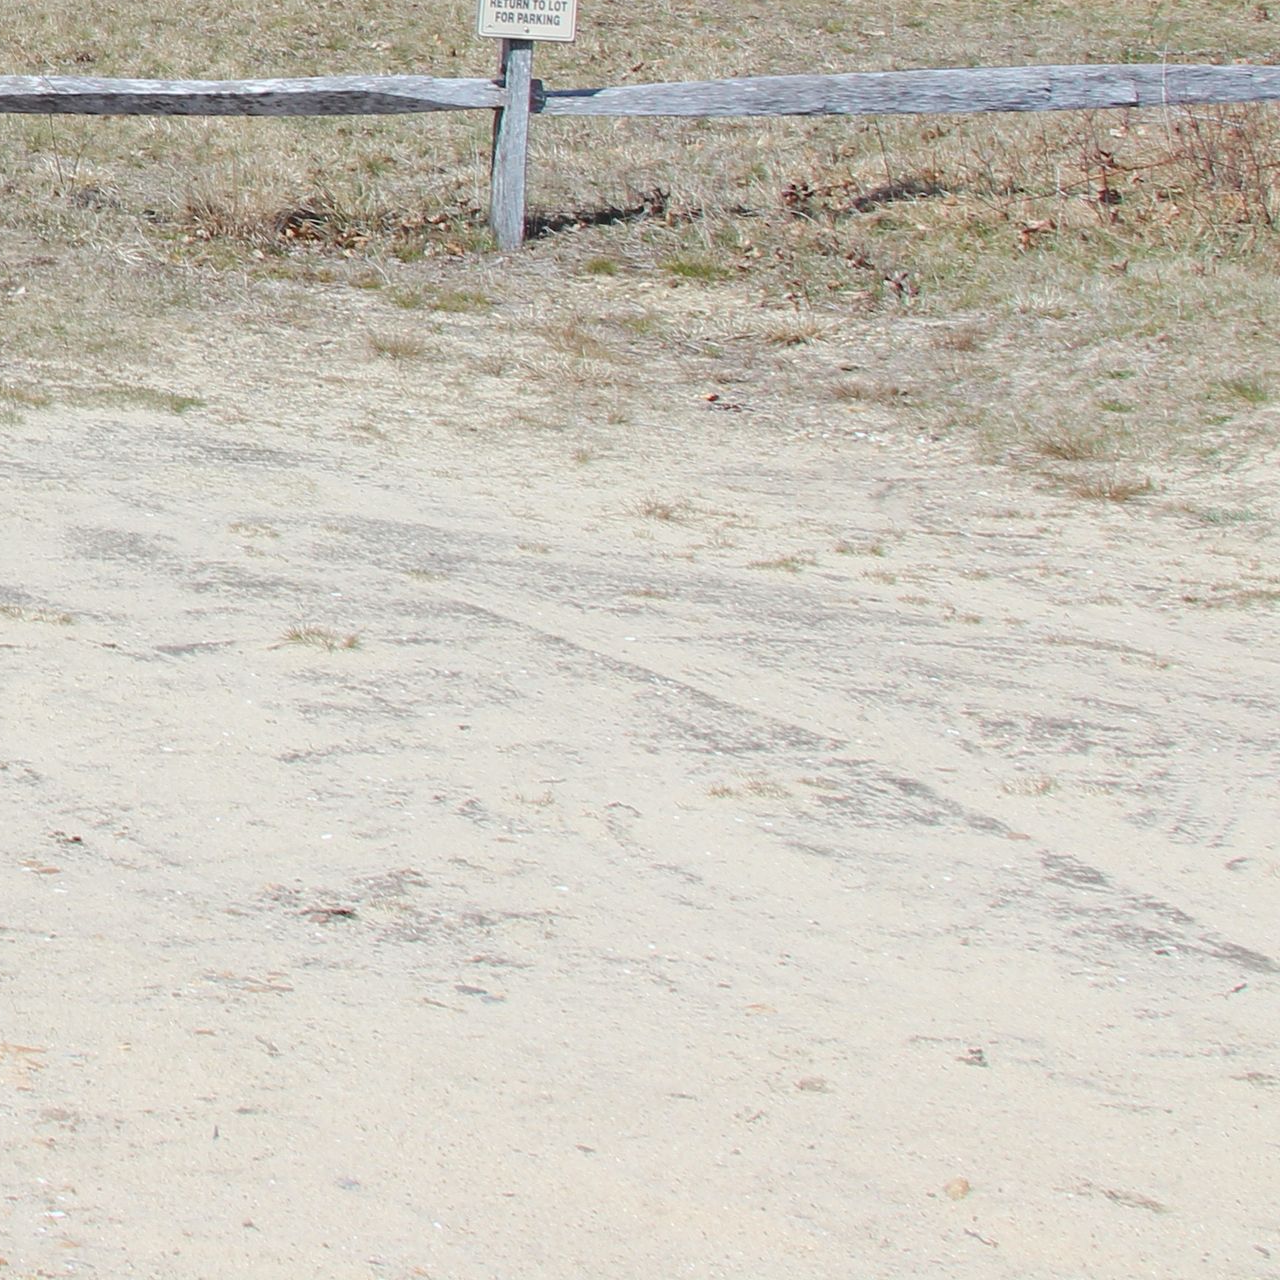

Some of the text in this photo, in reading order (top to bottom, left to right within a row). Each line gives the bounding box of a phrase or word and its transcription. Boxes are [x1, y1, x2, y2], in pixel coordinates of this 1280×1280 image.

[533, 0, 546, 11] TO
[549, 0, 568, 12] LOT
[495, 11, 560, 26] FOR PARKING
